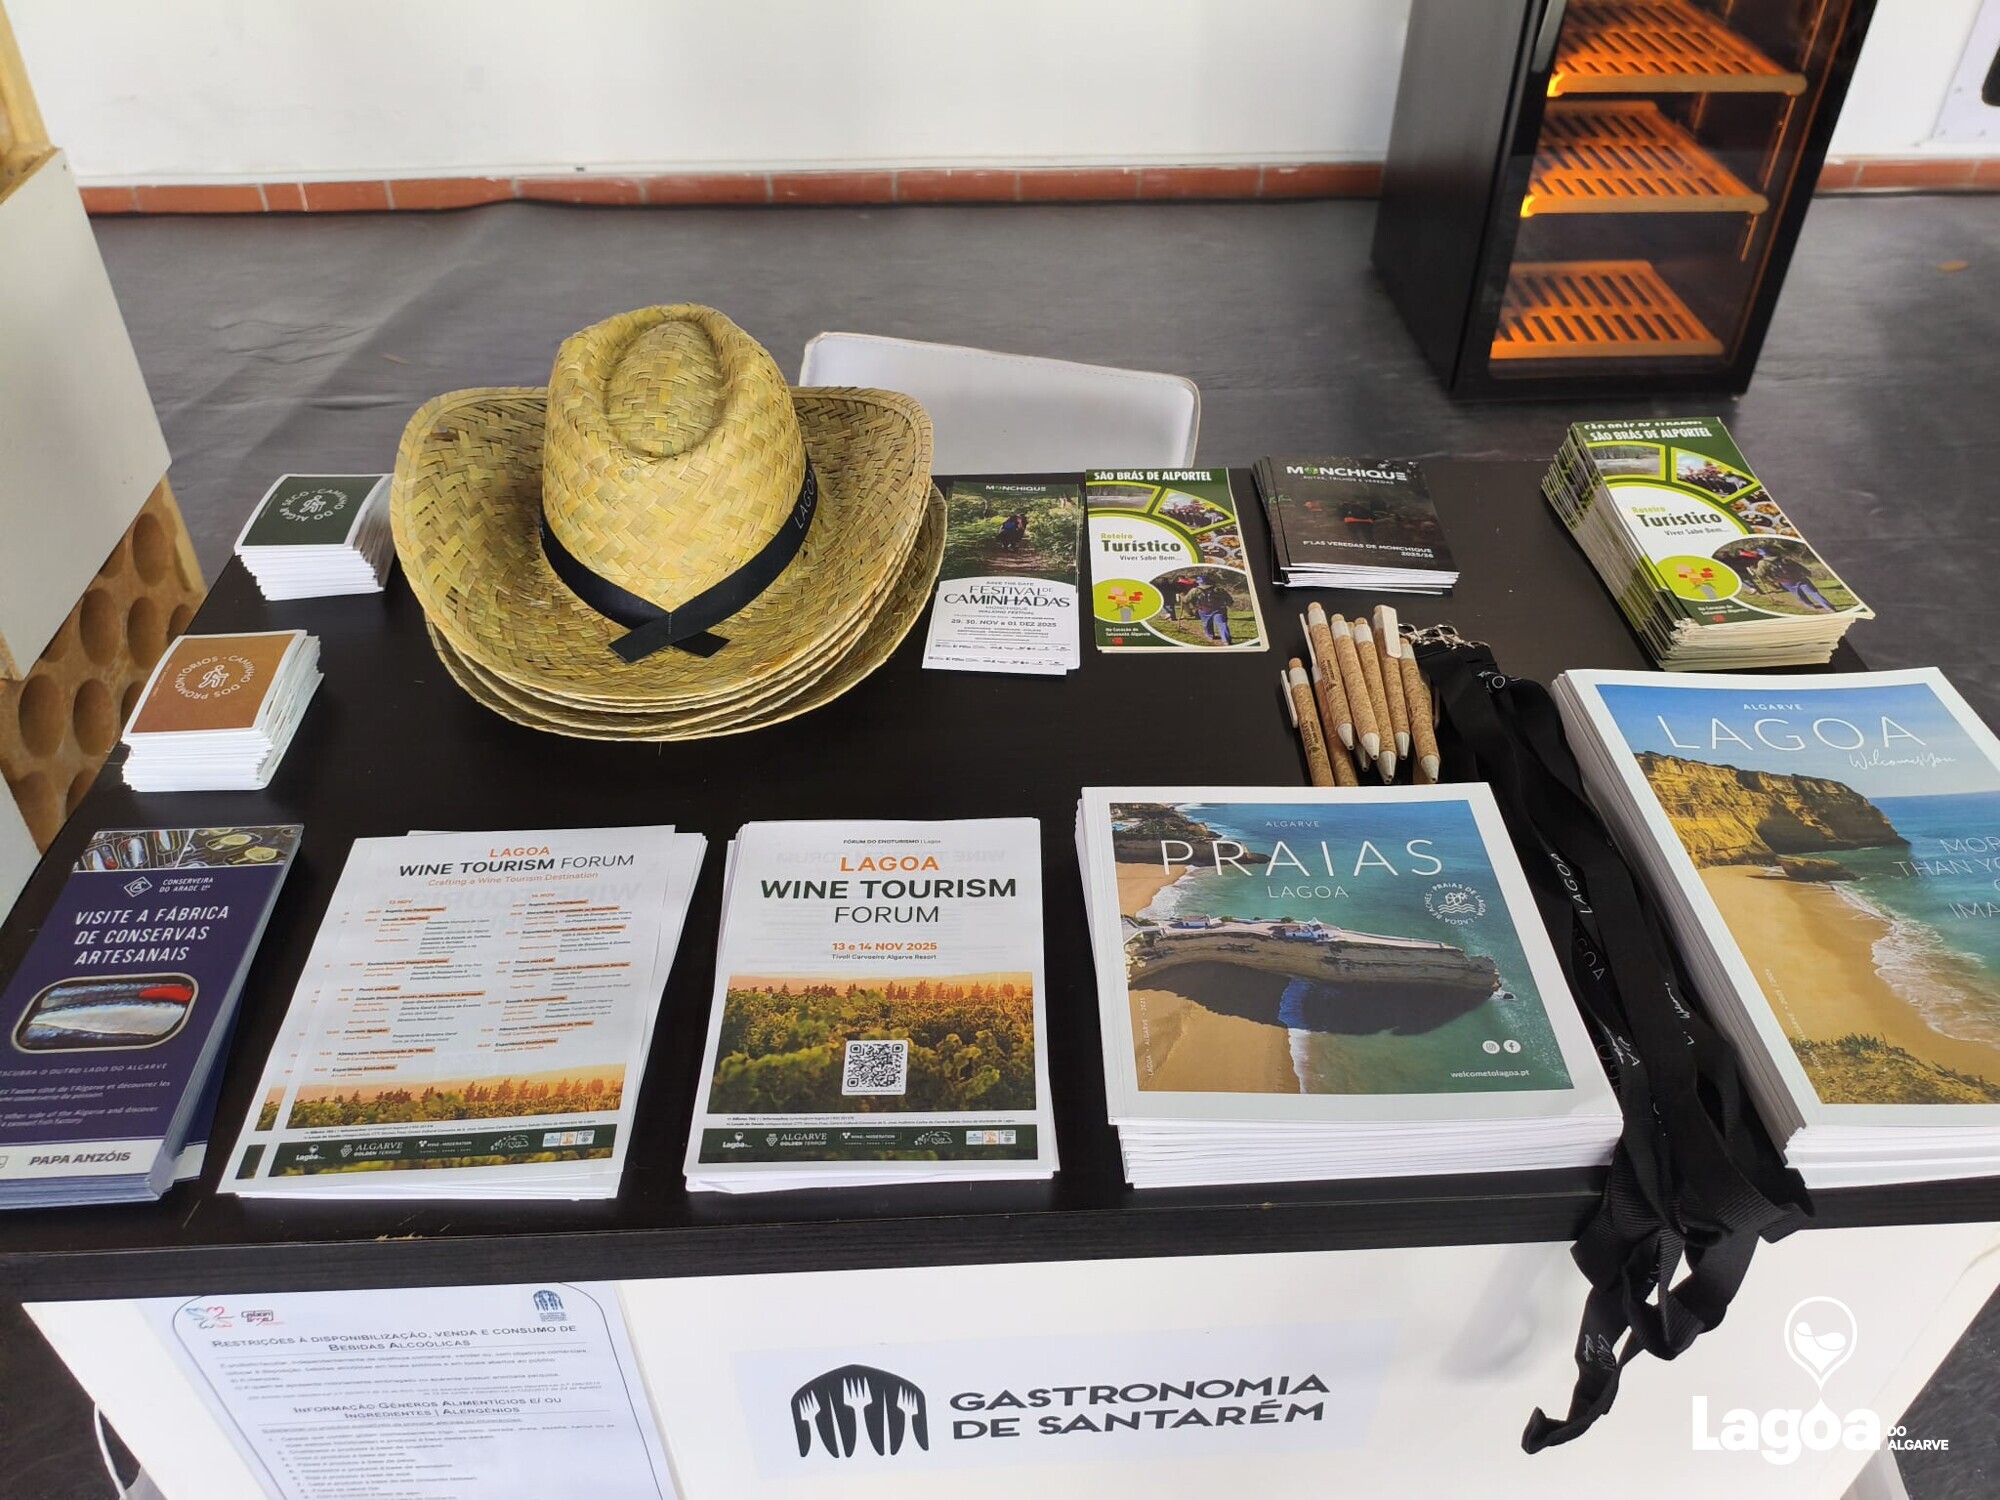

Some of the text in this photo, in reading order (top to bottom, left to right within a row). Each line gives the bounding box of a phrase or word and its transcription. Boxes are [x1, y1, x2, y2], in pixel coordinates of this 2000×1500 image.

[1590, 427, 1713, 441] SÃO BRÁS DE ALPORTEL
[1094, 470, 1212, 481] SÃO BRÁS DE ALPORTEL
[1636, 511, 1722, 527] Turístico
[1101, 539, 1181, 552] Turístico
[970, 585, 1040, 596] FESTIVAL
[944, 593, 1070, 608] CAMINHADAS
[214, 684, 240, 698] DOS
[1743, 703, 1803, 711] ALGARVE
[1657, 715, 1927, 751] LAGOA
[1265, 820, 1320, 828] ALGARVE
[489, 846, 551, 858] LAGOA
[1940, 836, 2000, 854] MOR
[400, 854, 635, 876] WINE TOURISM FORUM
[840, 856, 940, 872] LAGOA
[1160, 839, 1443, 878] PRAIAS
[1891, 859, 1973, 877] THAN
[428, 877, 467, 887] Crafting
[478, 876, 502, 884] Wine
[505, 874, 543, 883] Tourism
[544, 872, 599, 882] Destination
[173, 885, 198, 893] ARADE
[761, 878, 1016, 899] WINE TOURISM
[1268, 885, 1349, 899] LAGOA
[75, 905, 229, 925] VISITE A FÁBRICA
[834, 906, 939, 923] FORUM
[1948, 901, 2000, 919] IMA
[74, 926, 210, 945] DE CONSERVAS
[906, 942, 937, 951] 2025
[74, 947, 190, 965] ARTESANAIS
[1450, 1070, 1530, 1078] welcometolagoa.pt
[781, 1133, 827, 1141] ALGARVE
[356, 1142, 403, 1151] ALGARVE
[29, 1150, 132, 1166] PAPA ANZÓIS
[493, 1326, 556, 1335] CONSUMO
[949, 1374, 1330, 1411] GASTRONOMIA
[344, 1409, 432, 1419] INGREDIENTES
[953, 1399, 1324, 1440] DE SANTARÉM
